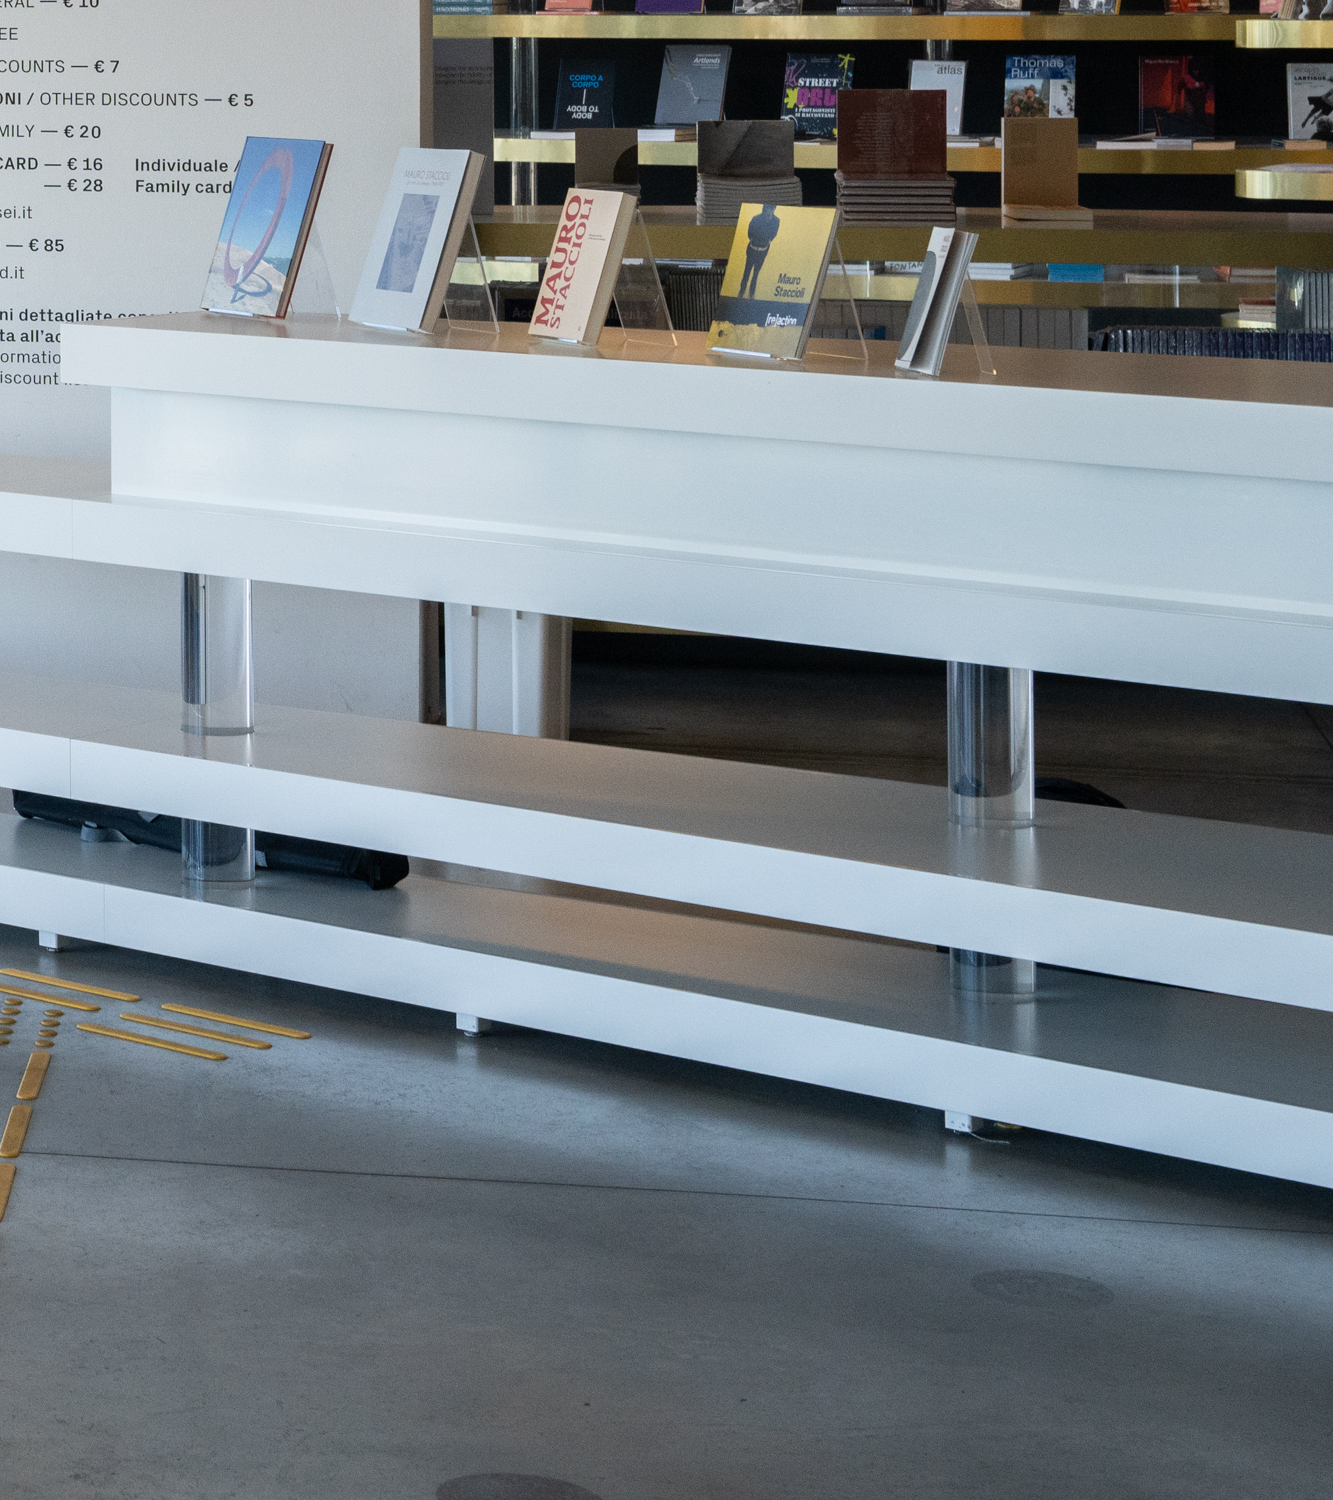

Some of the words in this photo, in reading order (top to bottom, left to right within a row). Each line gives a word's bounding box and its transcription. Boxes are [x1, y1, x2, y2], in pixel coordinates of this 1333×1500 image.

[94, 59, 104, 74] €
[110, 60, 119, 74] 7
[937, 65, 963, 75] atlas
[1013, 57, 1064, 68] Thomas
[569, 74, 597, 82] CORPO
[597, 74, 604, 82] A
[1011, 68, 1040, 79] Ruff
[798, 78, 839, 87] STREET
[27, 92, 34, 106] /
[40, 91, 95, 106] OTHER
[102, 92, 198, 107] DISCOUNTS
[228, 93, 238, 107] €
[244, 93, 253, 107] 5
[64, 124, 74, 139] €
[80, 124, 101, 139] 20
[67, 157, 77, 171] €
[83, 157, 102, 172] 16
[136, 158, 228, 173] Individuale
[67, 178, 77, 192] €
[83, 178, 103, 193] 28
[135, 180, 191, 195] Family
[196, 180, 233, 193] card
[29, 238, 38, 252] €
[44, 238, 64, 253] 85
[534, 194, 582, 327] MAURO
[549, 197, 594, 329] STACCIOLI
[777, 273, 801, 286] Mauro
[774, 286, 805, 299] Staccioli
[765, 312, 797, 327] [re]action
